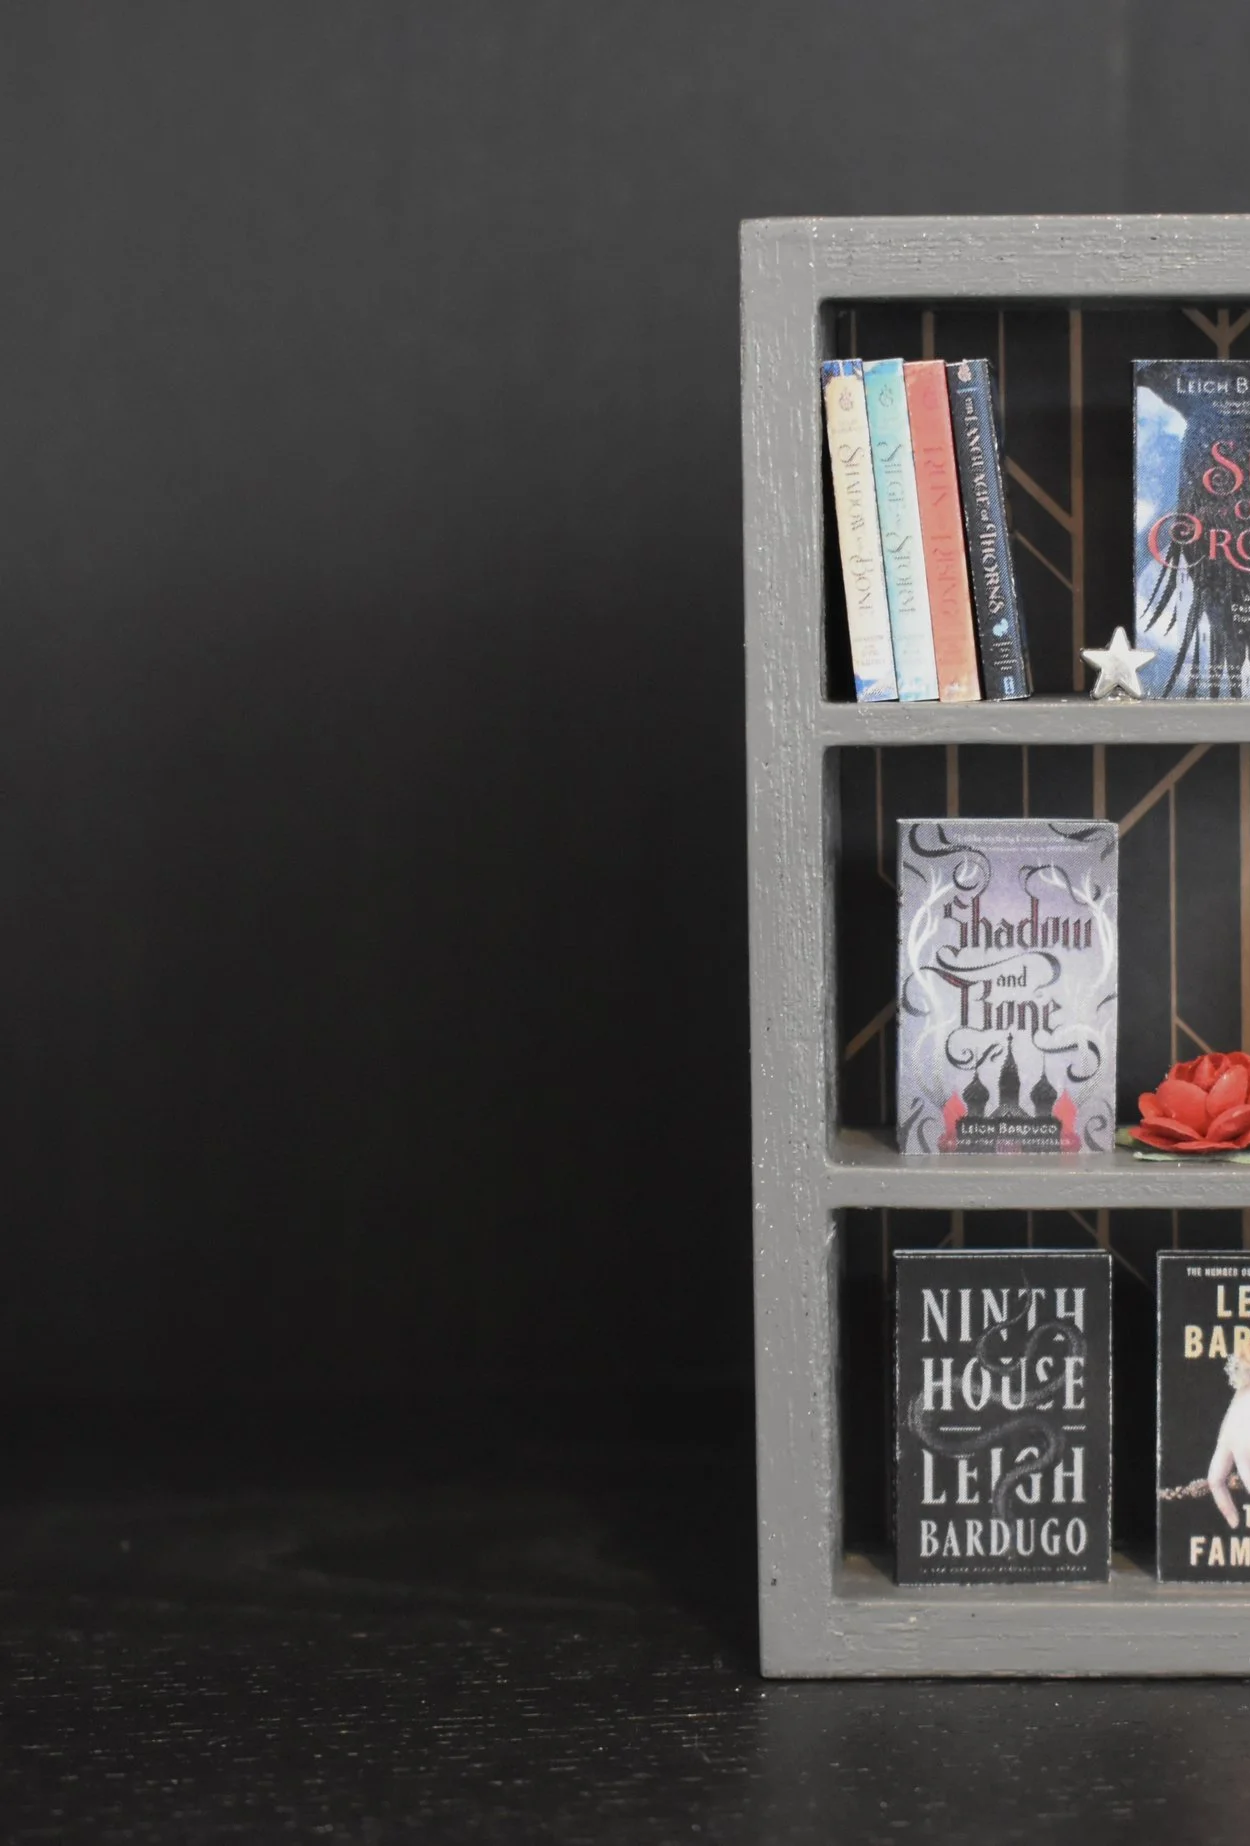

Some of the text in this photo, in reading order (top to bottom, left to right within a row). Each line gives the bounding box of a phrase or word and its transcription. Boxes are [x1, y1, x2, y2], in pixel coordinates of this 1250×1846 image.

[1177, 377, 1229, 395] LEIGH
[979, 522, 1006, 615] THORNS
[943, 890, 1093, 957] Shadow
[940, 968, 1064, 1040] Bone
[997, 965, 1027, 988] and
[961, 1121, 1058, 1136] LEIGH BARDUGO
[921, 1287, 1086, 1342] NINTH
[921, 1356, 1086, 1411] HOUSE
[921, 1446, 1086, 1505] LEIGH
[919, 1516, 1087, 1557] BARDUGO
